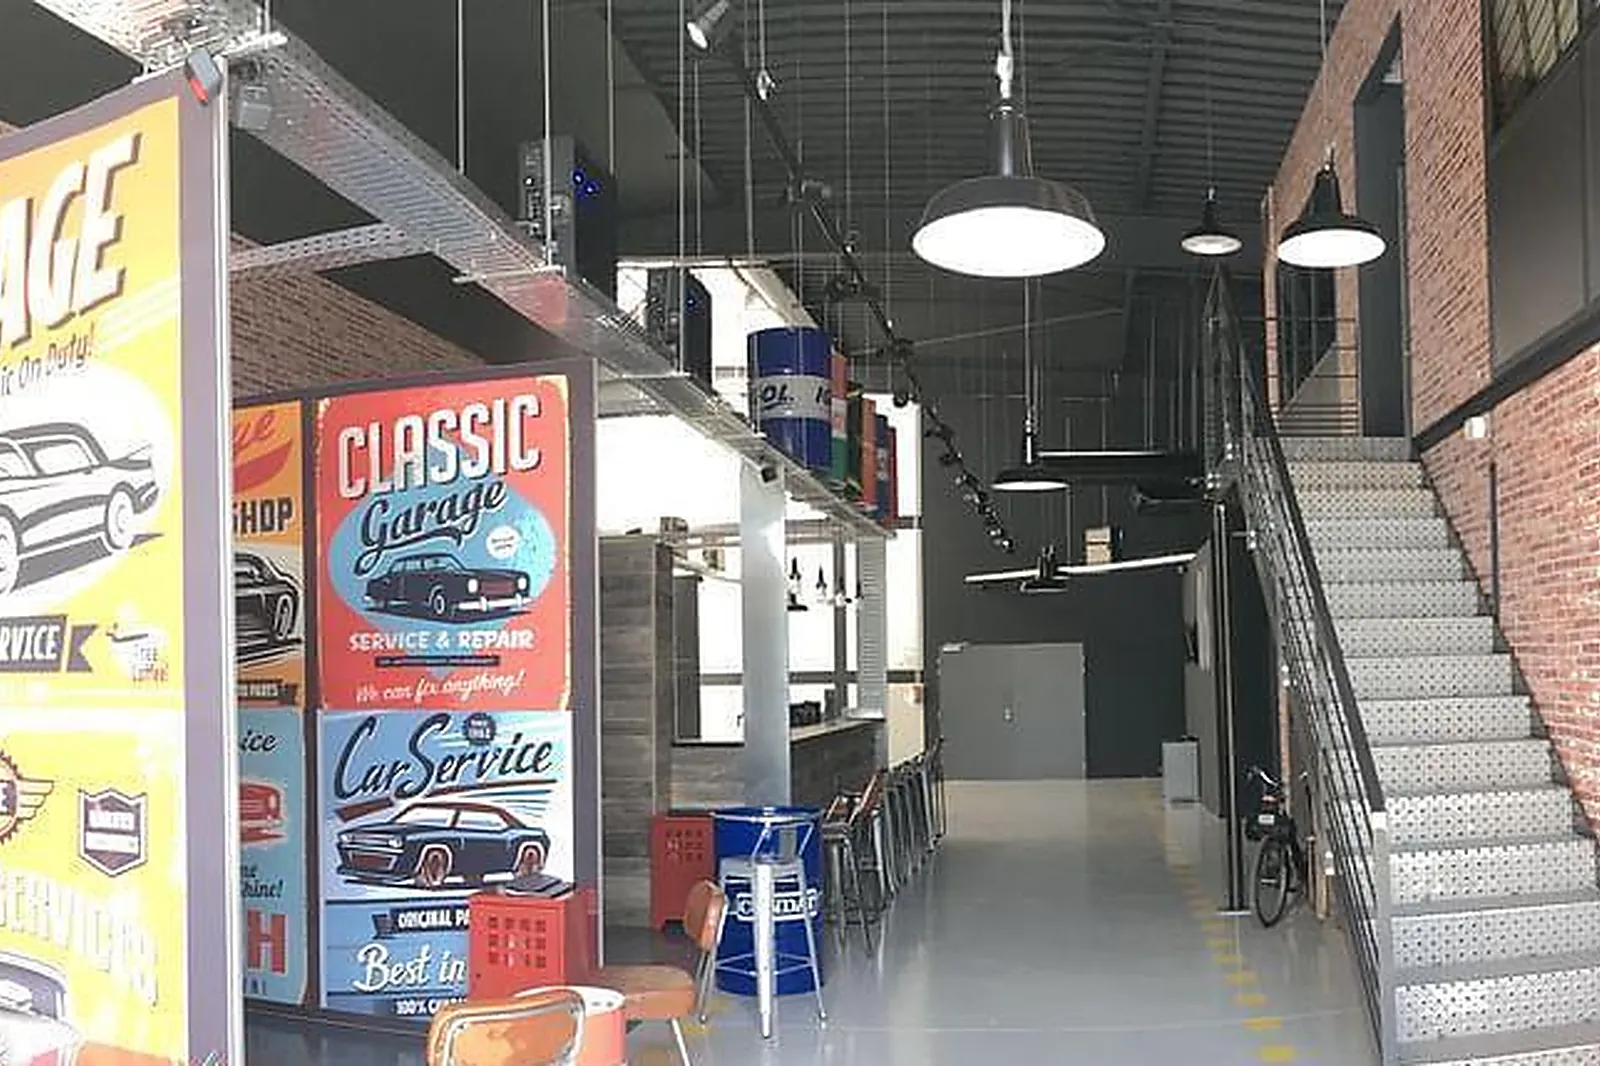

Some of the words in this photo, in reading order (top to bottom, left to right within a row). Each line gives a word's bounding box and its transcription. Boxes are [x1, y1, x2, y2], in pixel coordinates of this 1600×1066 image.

[19, 355, 42, 389] On
[337, 394, 542, 499] CLASSIC
[353, 480, 507, 577] Garage
[348, 631, 430, 651] SERVICE
[436, 632, 450, 649] &
[458, 629, 536, 650] REPAIR
[356, 682, 379, 703] We
[383, 685, 413, 700] can
[442, 668, 528, 702] anything!
[333, 715, 410, 800] Car
[394, 712, 553, 799] Service
[353, 942, 432, 992] Best
[439, 951, 466, 982] in
